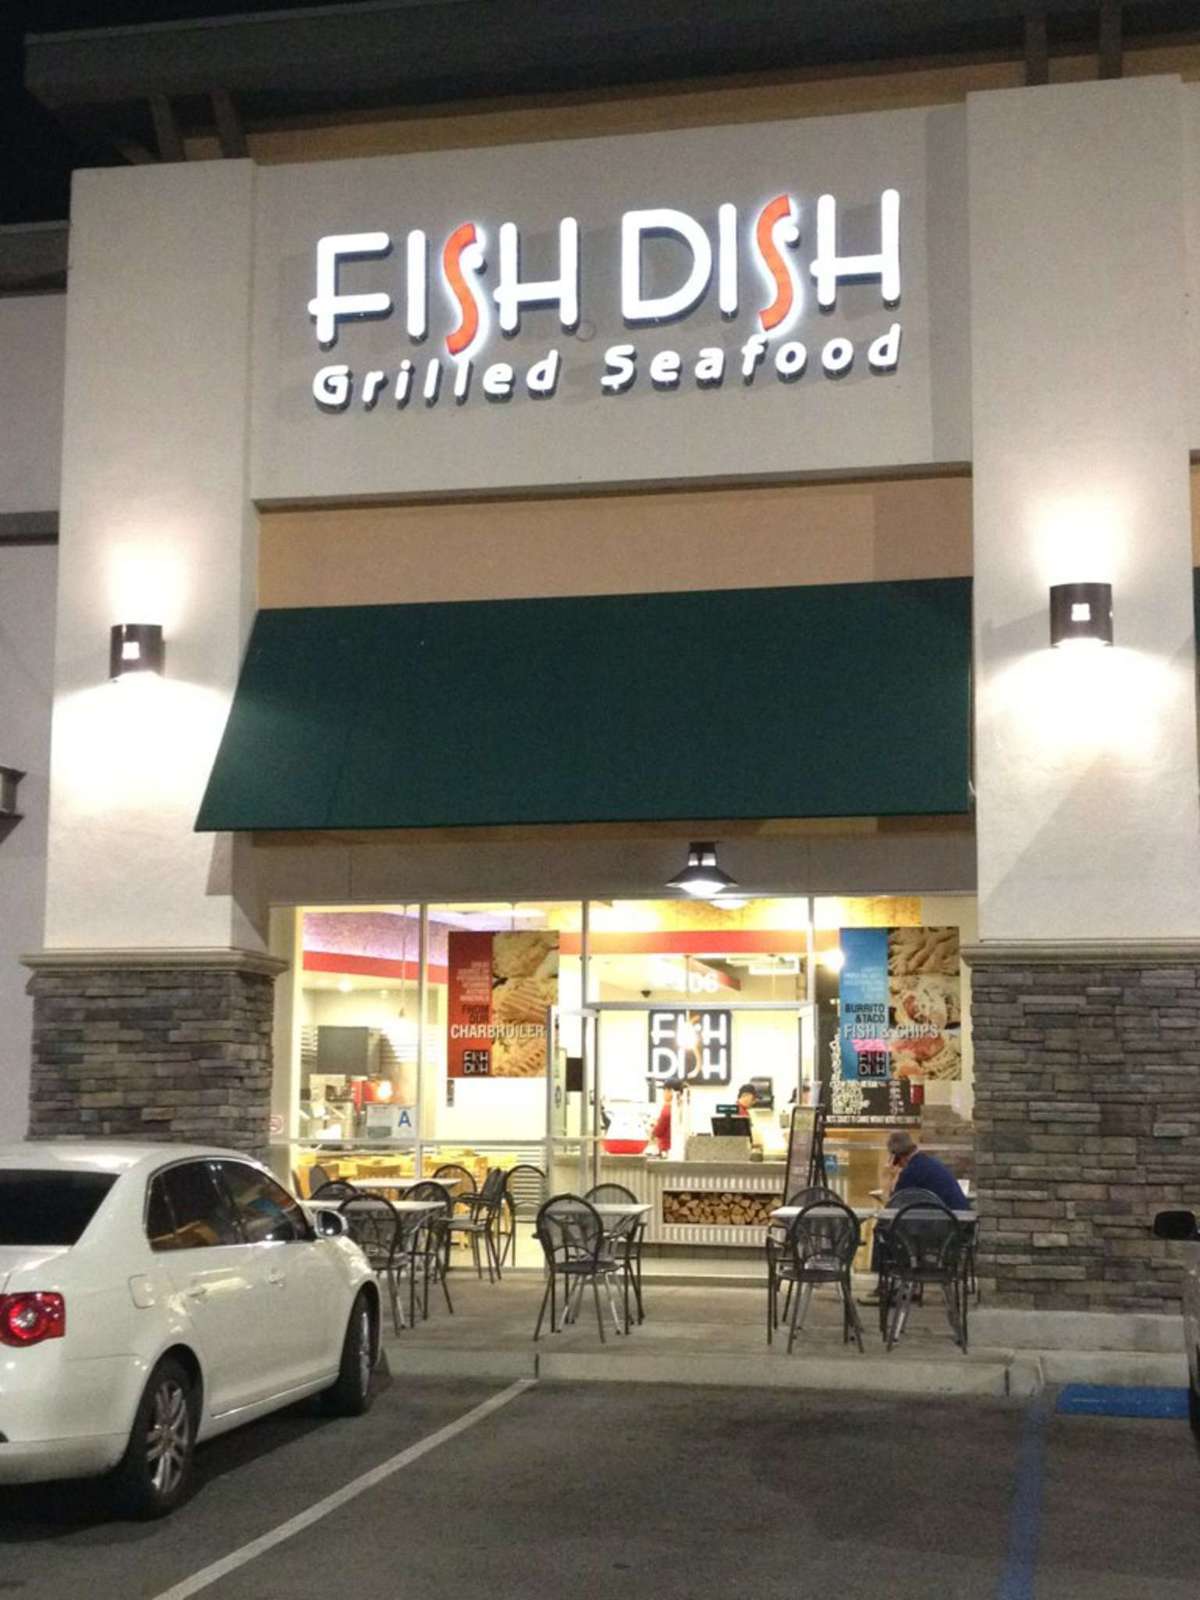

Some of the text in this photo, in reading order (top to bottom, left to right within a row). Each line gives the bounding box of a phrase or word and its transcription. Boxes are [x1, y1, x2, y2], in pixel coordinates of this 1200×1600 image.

[308, 188, 901, 357] FISH DISH
[312, 323, 901, 405] Grilled Seafood
[845, 1003, 885, 1013] BURRITO
[450, 1023, 546, 1039] CHARBROILER
[844, 1024, 875, 1039] FISH
[895, 1023, 940, 1039] CHIPS
[398, 1110, 411, 1128] A
